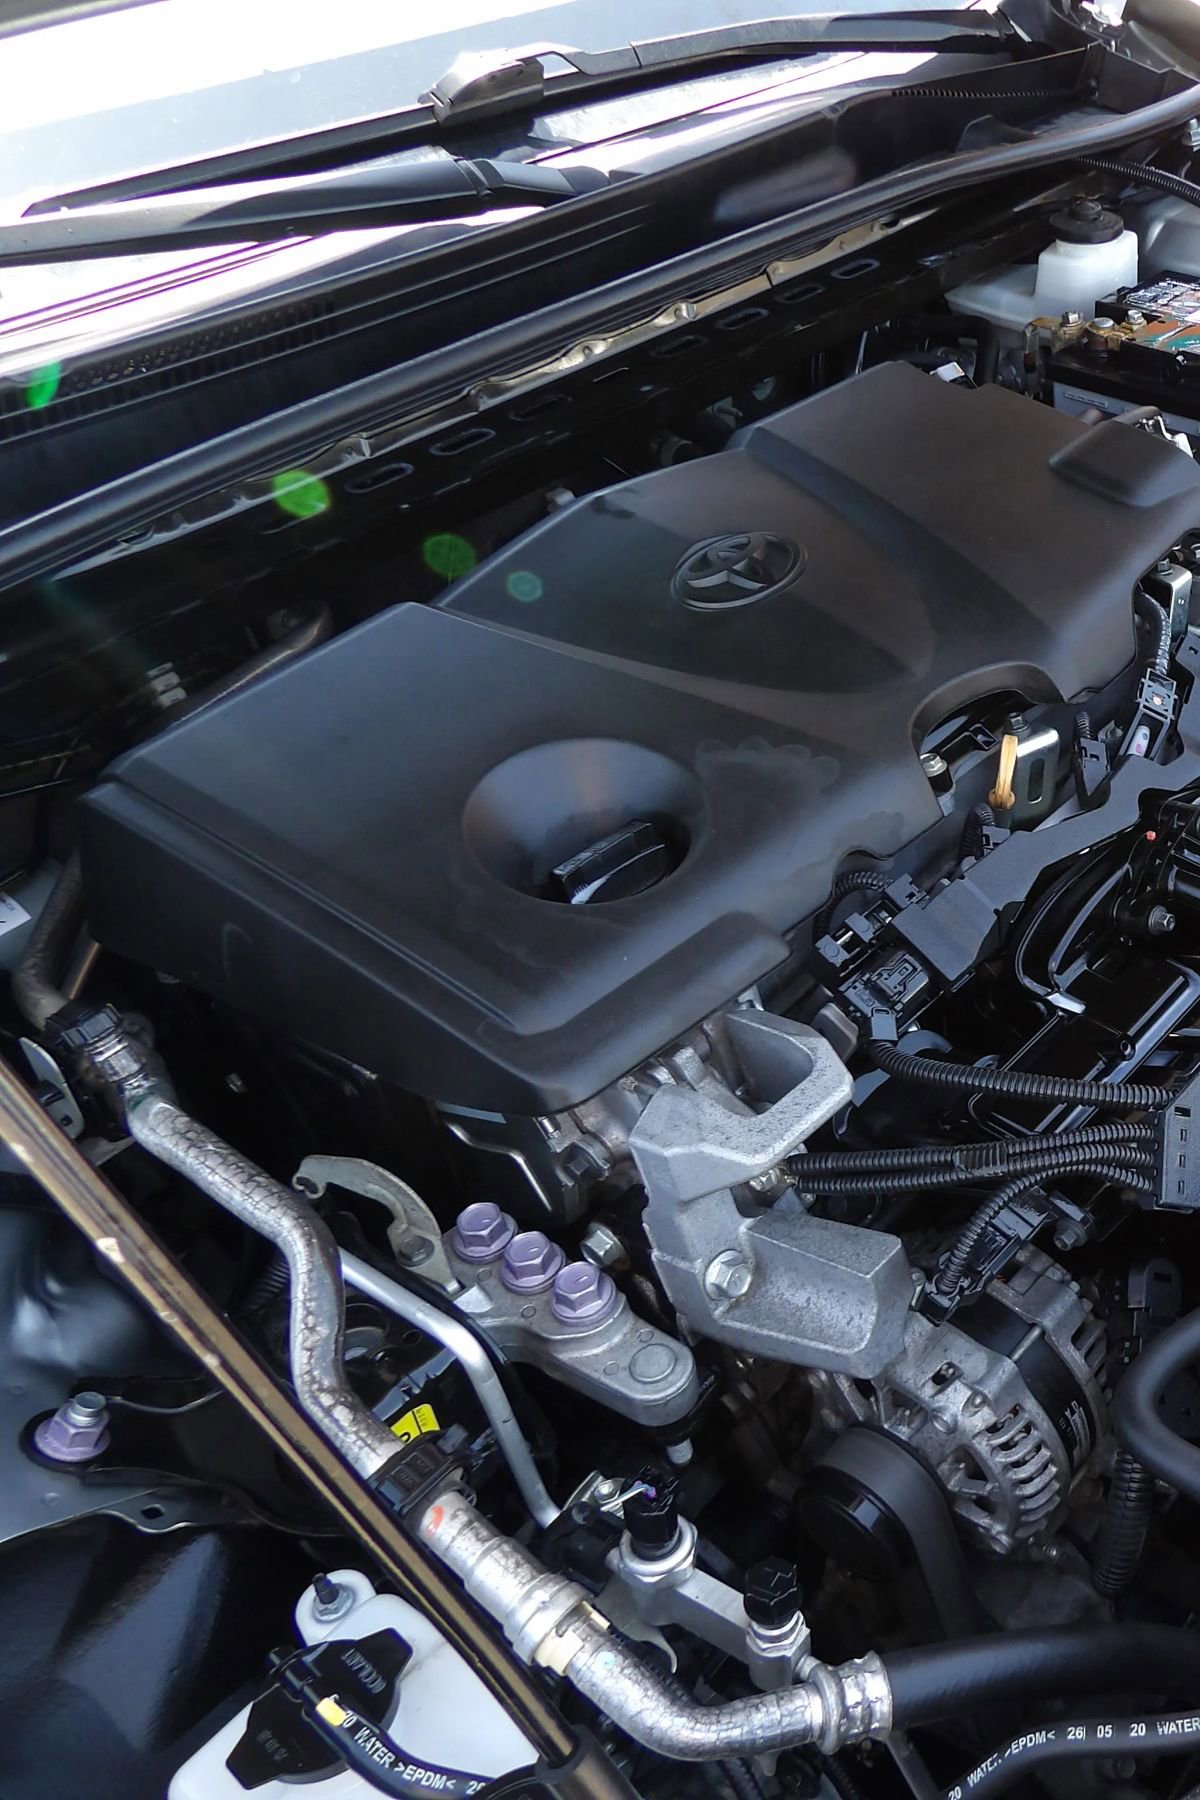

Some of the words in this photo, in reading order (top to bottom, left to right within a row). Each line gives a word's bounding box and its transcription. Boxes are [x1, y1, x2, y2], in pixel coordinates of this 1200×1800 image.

[1097, 1724, 1113, 1739] 05
[1129, 1722, 1146, 1737] 20
[354, 1726, 395, 1768] WATER
[393, 1761, 457, 1790] >EPDM<
